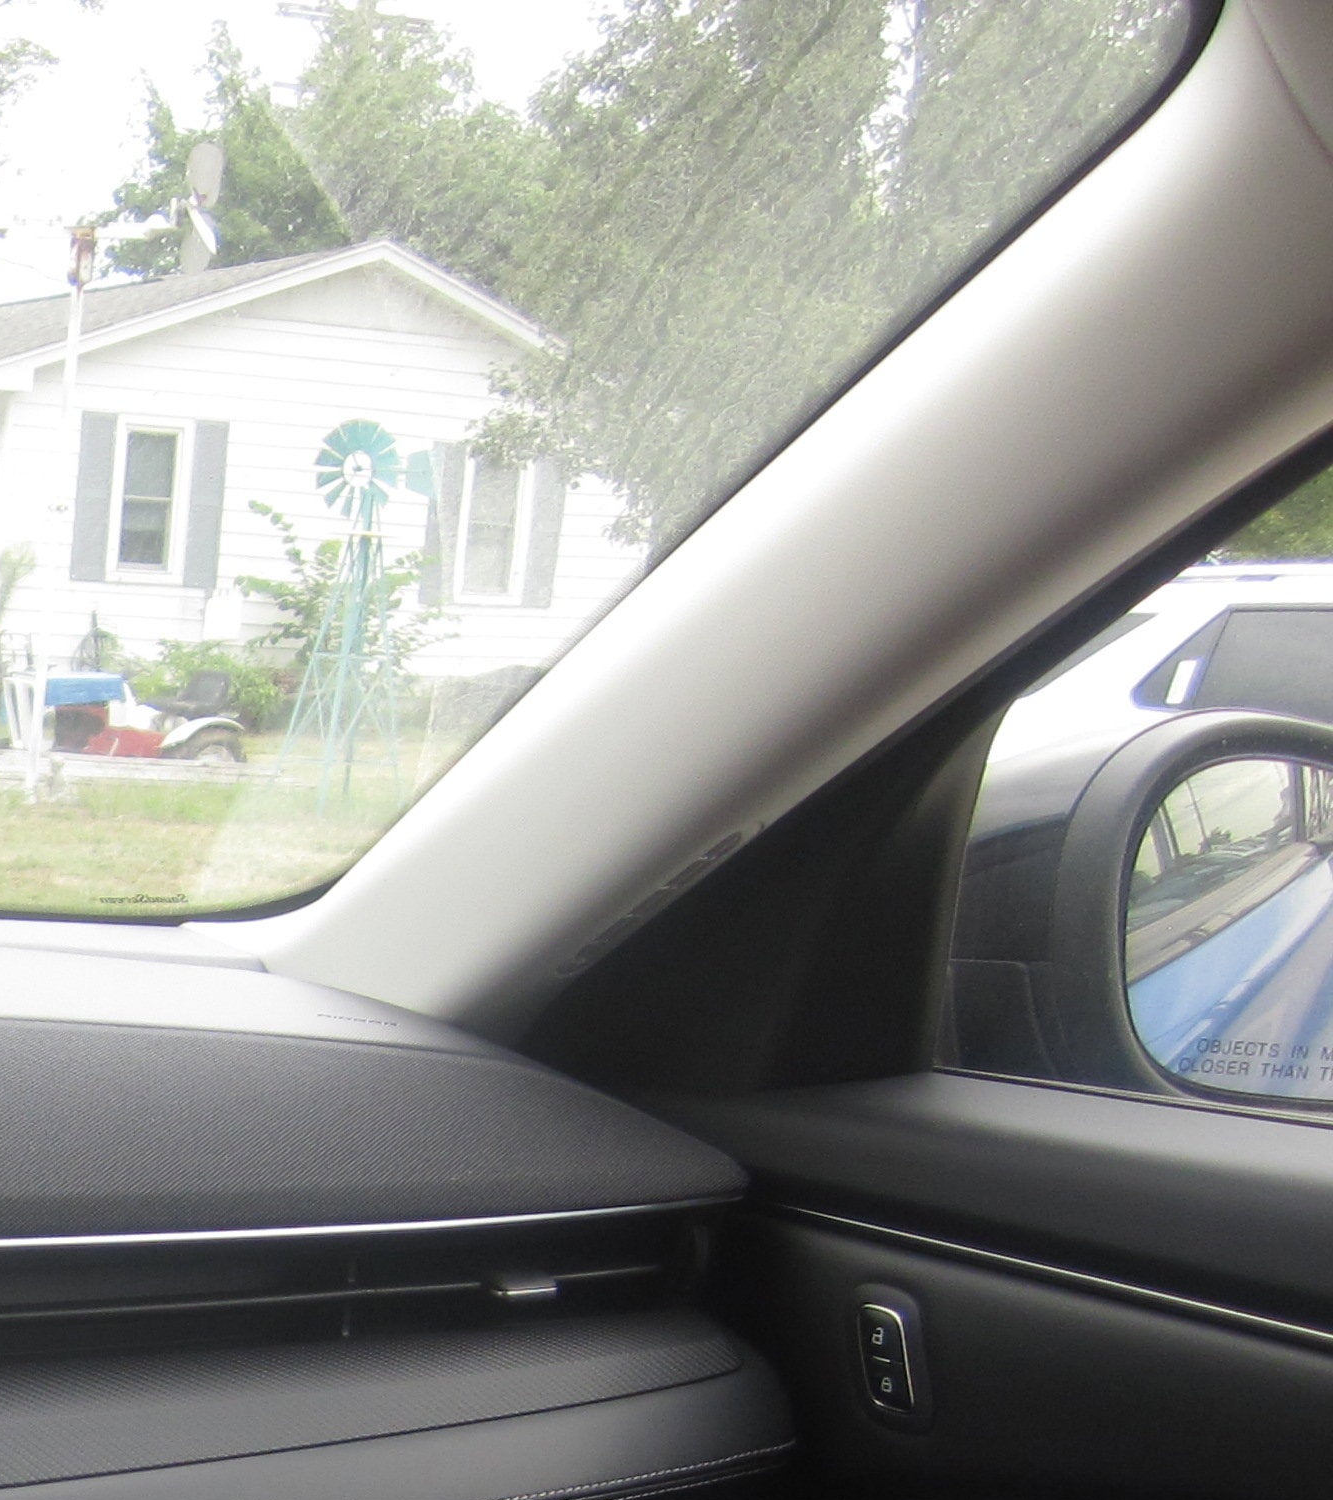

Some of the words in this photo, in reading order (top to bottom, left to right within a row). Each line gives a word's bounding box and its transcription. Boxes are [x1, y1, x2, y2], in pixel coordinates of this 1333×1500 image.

[1196, 1038, 1281, 1058] OBJECTS
[1291, 1045, 1309, 1059] IN
[1179, 1057, 1250, 1075] CLOSER
[1262, 1063, 1309, 1079] THAN
